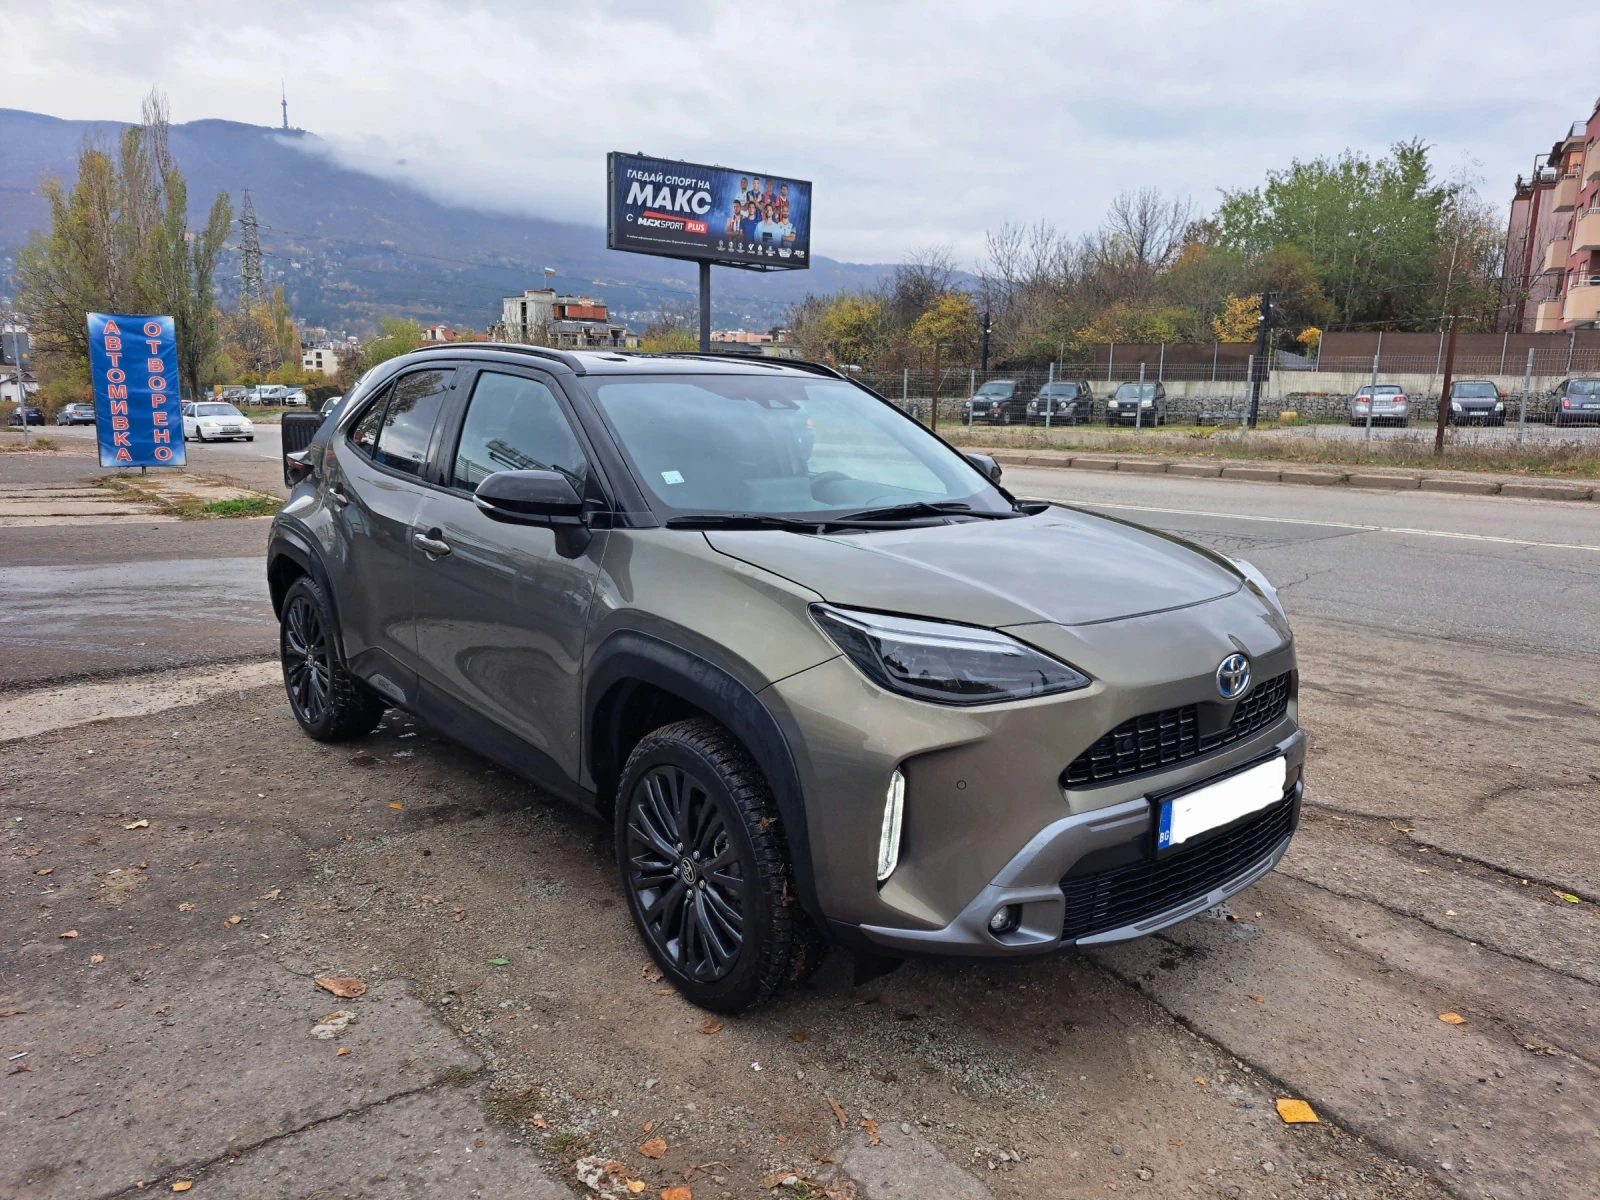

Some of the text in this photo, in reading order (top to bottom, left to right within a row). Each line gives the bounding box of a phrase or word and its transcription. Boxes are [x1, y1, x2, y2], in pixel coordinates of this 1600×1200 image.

[627, 169, 710, 189] ГЛЕДАЙ СПОРТ НА
[626, 181, 712, 215] МАКС
[687, 222, 705, 232] PLUS
[103, 320, 132, 461] АВТОМИВКА
[144, 322, 172, 460] ОТВОРЕНО
[1160, 830, 1170, 843] BG
